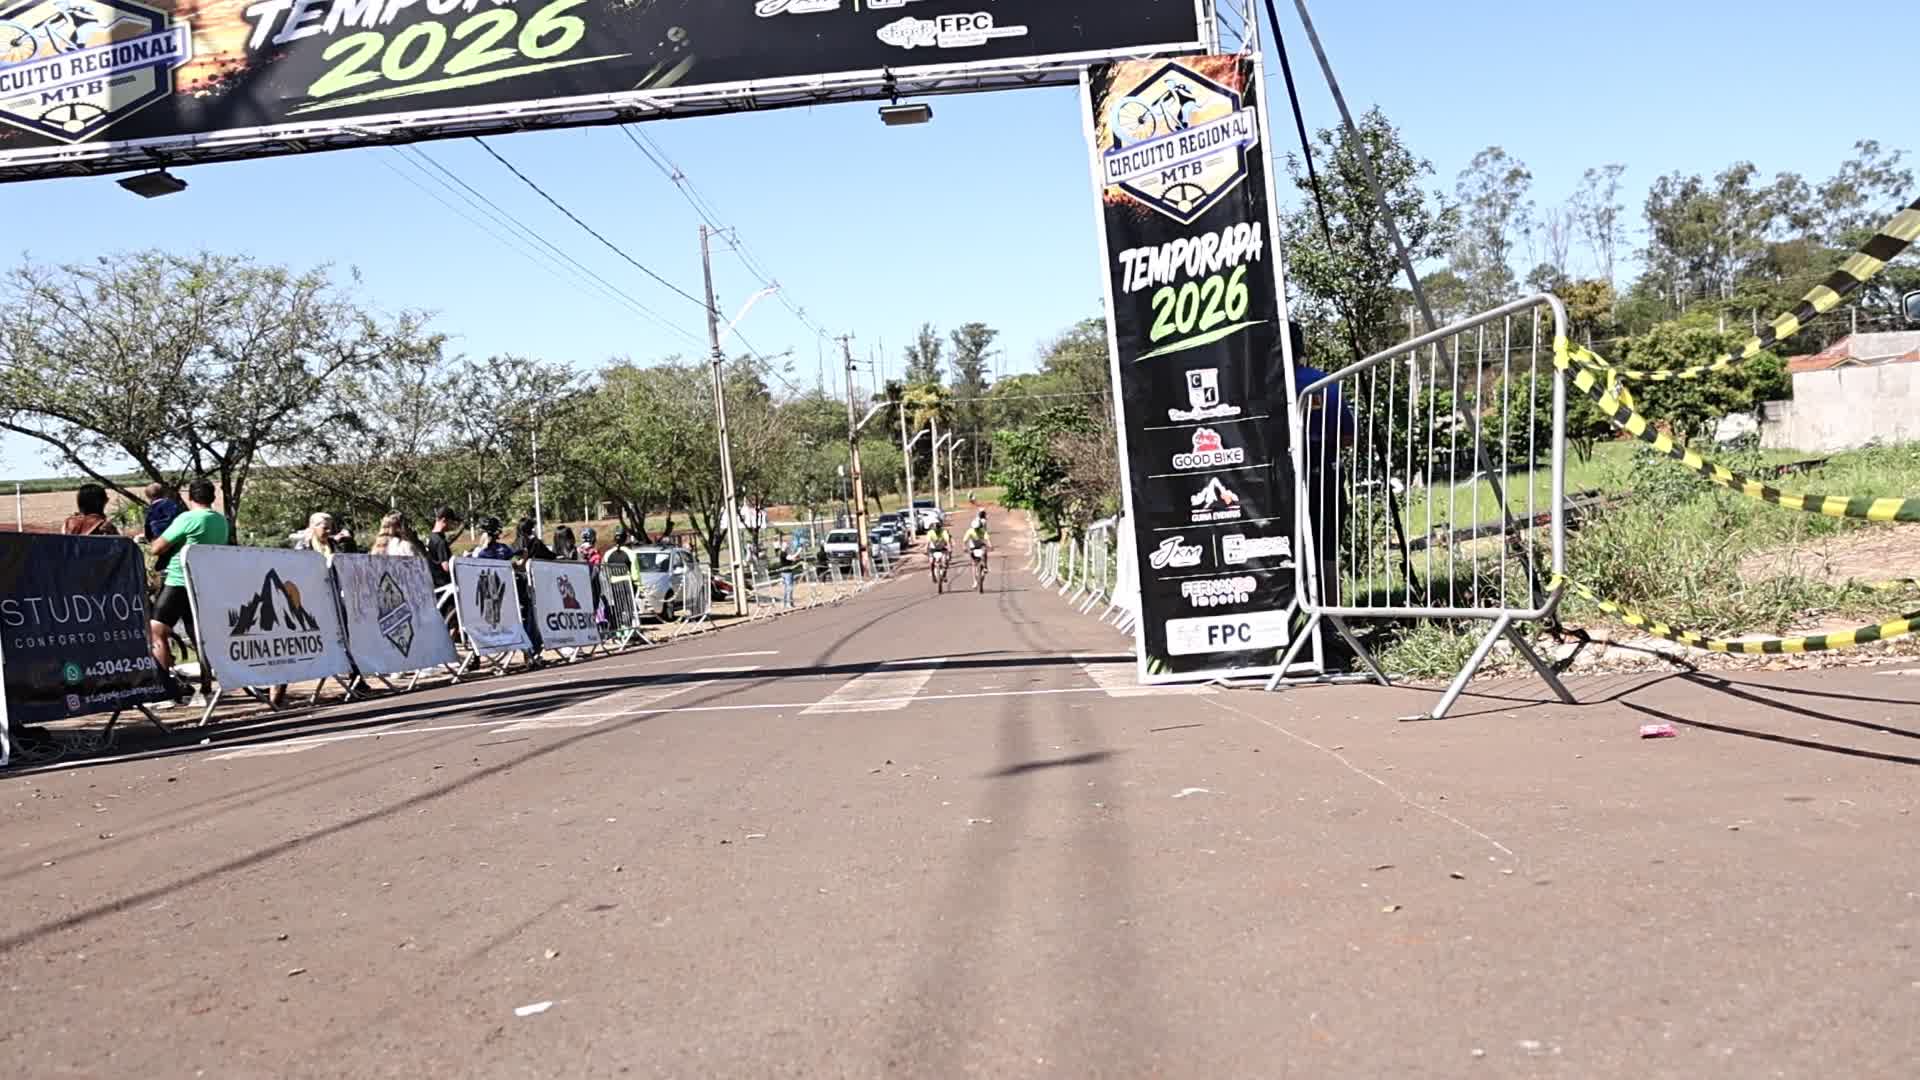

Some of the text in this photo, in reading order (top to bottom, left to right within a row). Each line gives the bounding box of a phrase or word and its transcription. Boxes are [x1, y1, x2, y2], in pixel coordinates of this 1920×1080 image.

[70, 35, 178, 77] REGIONAL
[307, 0, 587, 98] 2026
[40, 80, 104, 106] MTB
[1109, 116, 1248, 177] CIRCUITO REGIONAL
[1161, 160, 1203, 184] MTB
[1119, 222, 1264, 294] TEMPORADA
[1150, 264, 1249, 343] 2026
[1174, 448, 1241, 468] GOOD BIKE
[15, 632, 96, 649] CONFORTO
[1207, 622, 1252, 646] FPC
[229, 635, 324, 662] GUINA EVENTOS
